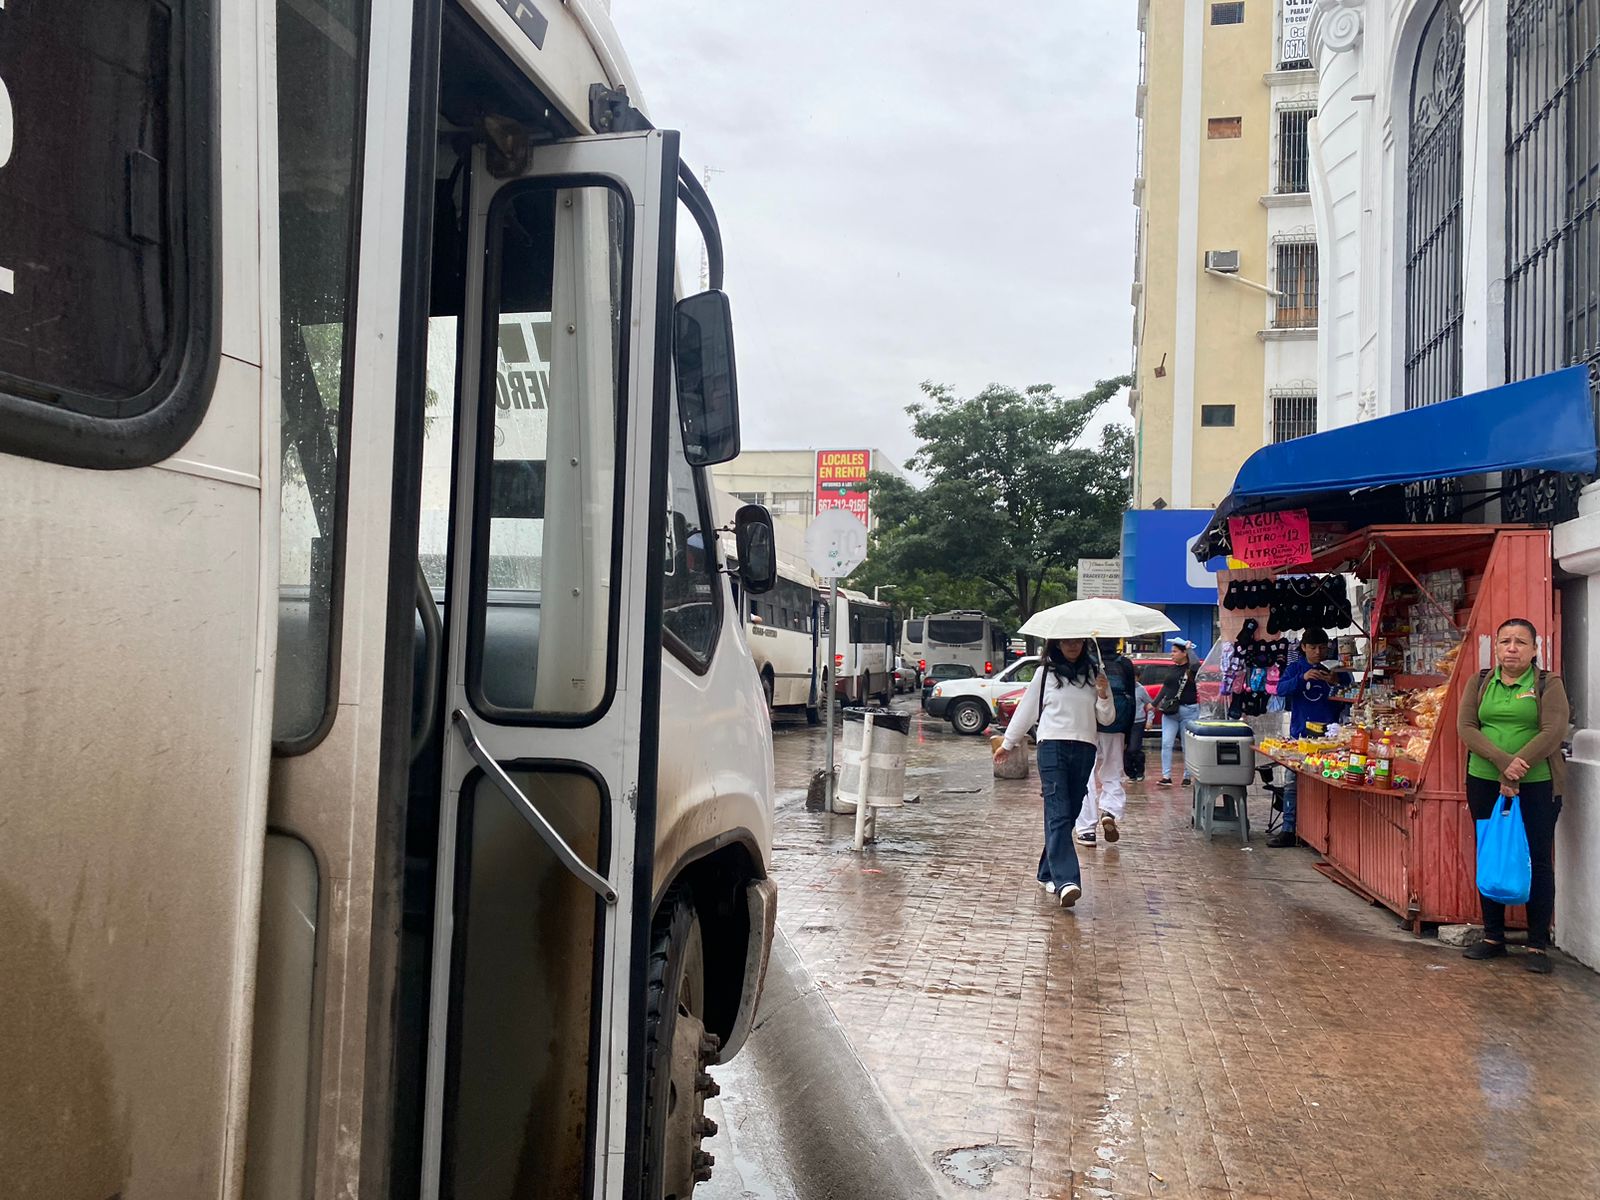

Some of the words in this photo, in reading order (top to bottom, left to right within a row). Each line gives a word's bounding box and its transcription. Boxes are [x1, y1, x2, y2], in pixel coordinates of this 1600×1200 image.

[822, 453, 864, 466] LOCALES
[819, 466, 832, 478] EN
[835, 466, 866, 478] RENTA
[1242, 512, 1283, 529] AGUA
[1248, 533, 1276, 544] LITRO
[1244, 547, 1278, 559] LITRO
